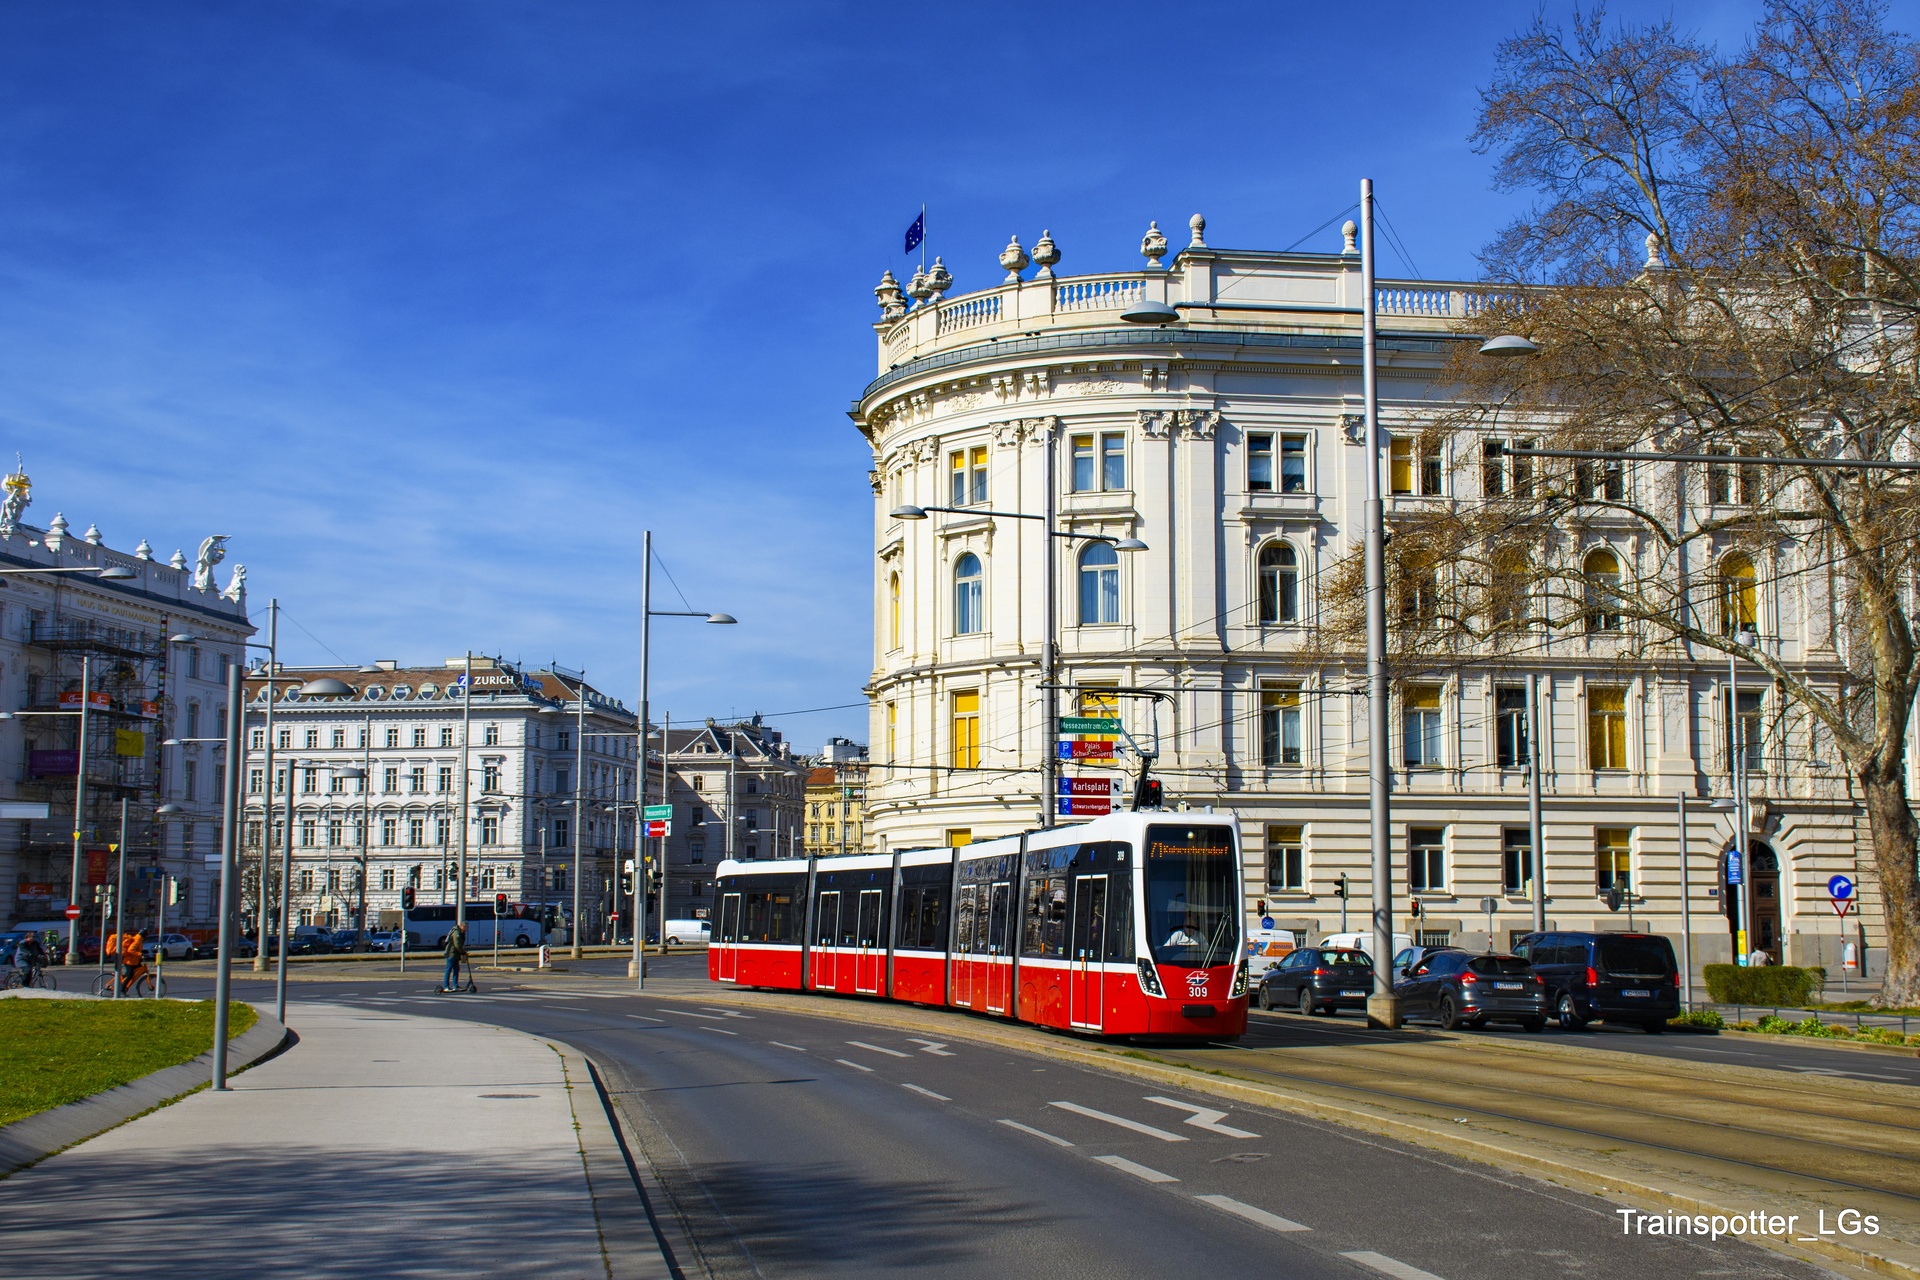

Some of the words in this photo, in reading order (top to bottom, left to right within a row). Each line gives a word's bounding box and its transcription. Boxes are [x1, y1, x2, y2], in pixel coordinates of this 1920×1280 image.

[474, 675, 514, 685] ZURICH
[1060, 721, 1101, 730] Messezentrum
[1072, 782, 1109, 793] Karlsplatz
[1150, 842, 1163, 858] 71
[1188, 986, 1208, 998] 309
